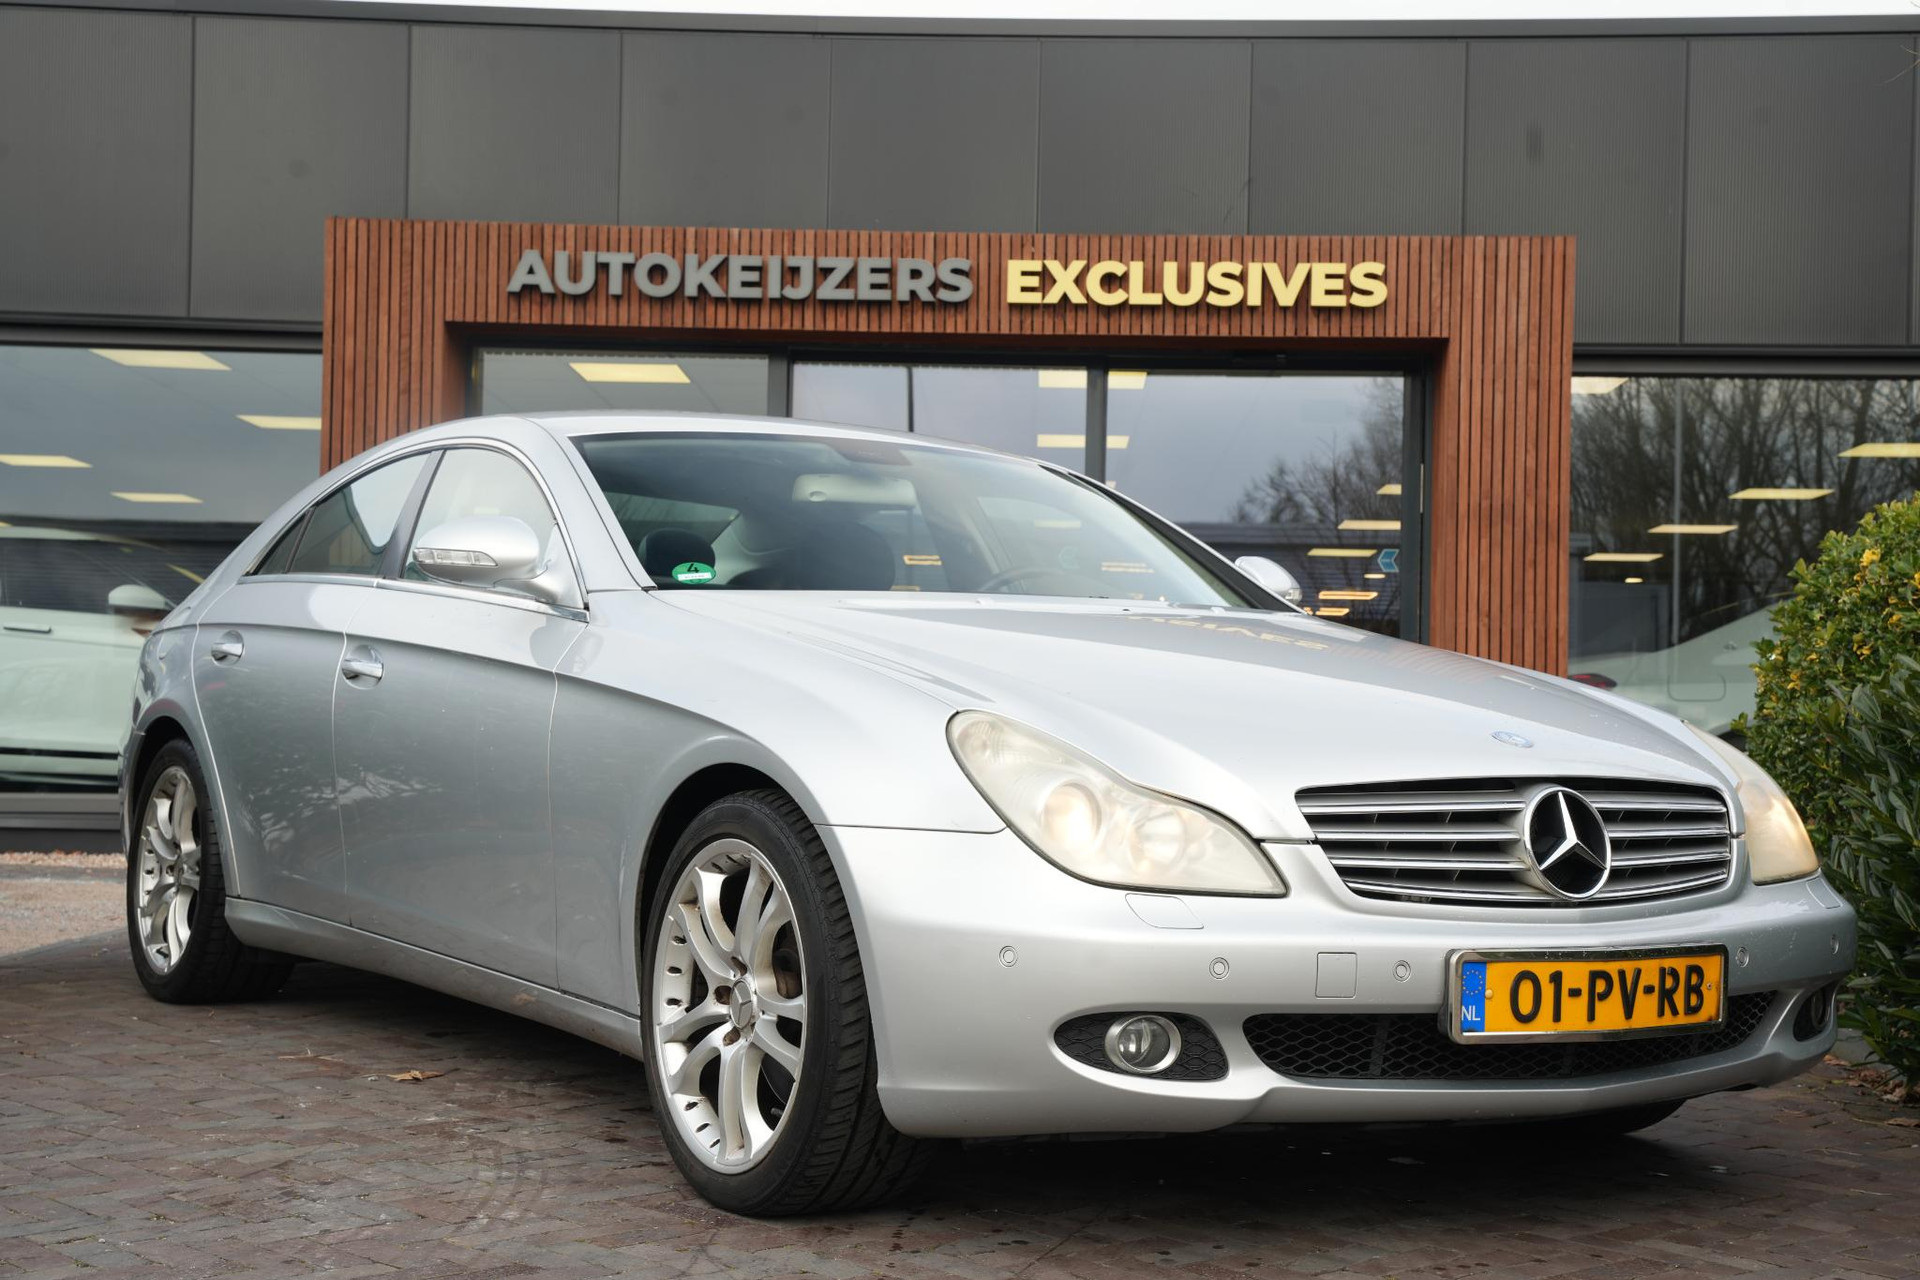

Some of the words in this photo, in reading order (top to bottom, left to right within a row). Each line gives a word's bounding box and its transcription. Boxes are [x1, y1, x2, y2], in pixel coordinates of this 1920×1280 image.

[506, 249, 974, 302] AUTOKEIJZERS
[1006, 259, 1388, 308] EXCLUSIVES
[686, 562, 700, 573] 4
[1509, 964, 1705, 1024] 01-PV-RB
[1461, 1005, 1481, 1021] NL
